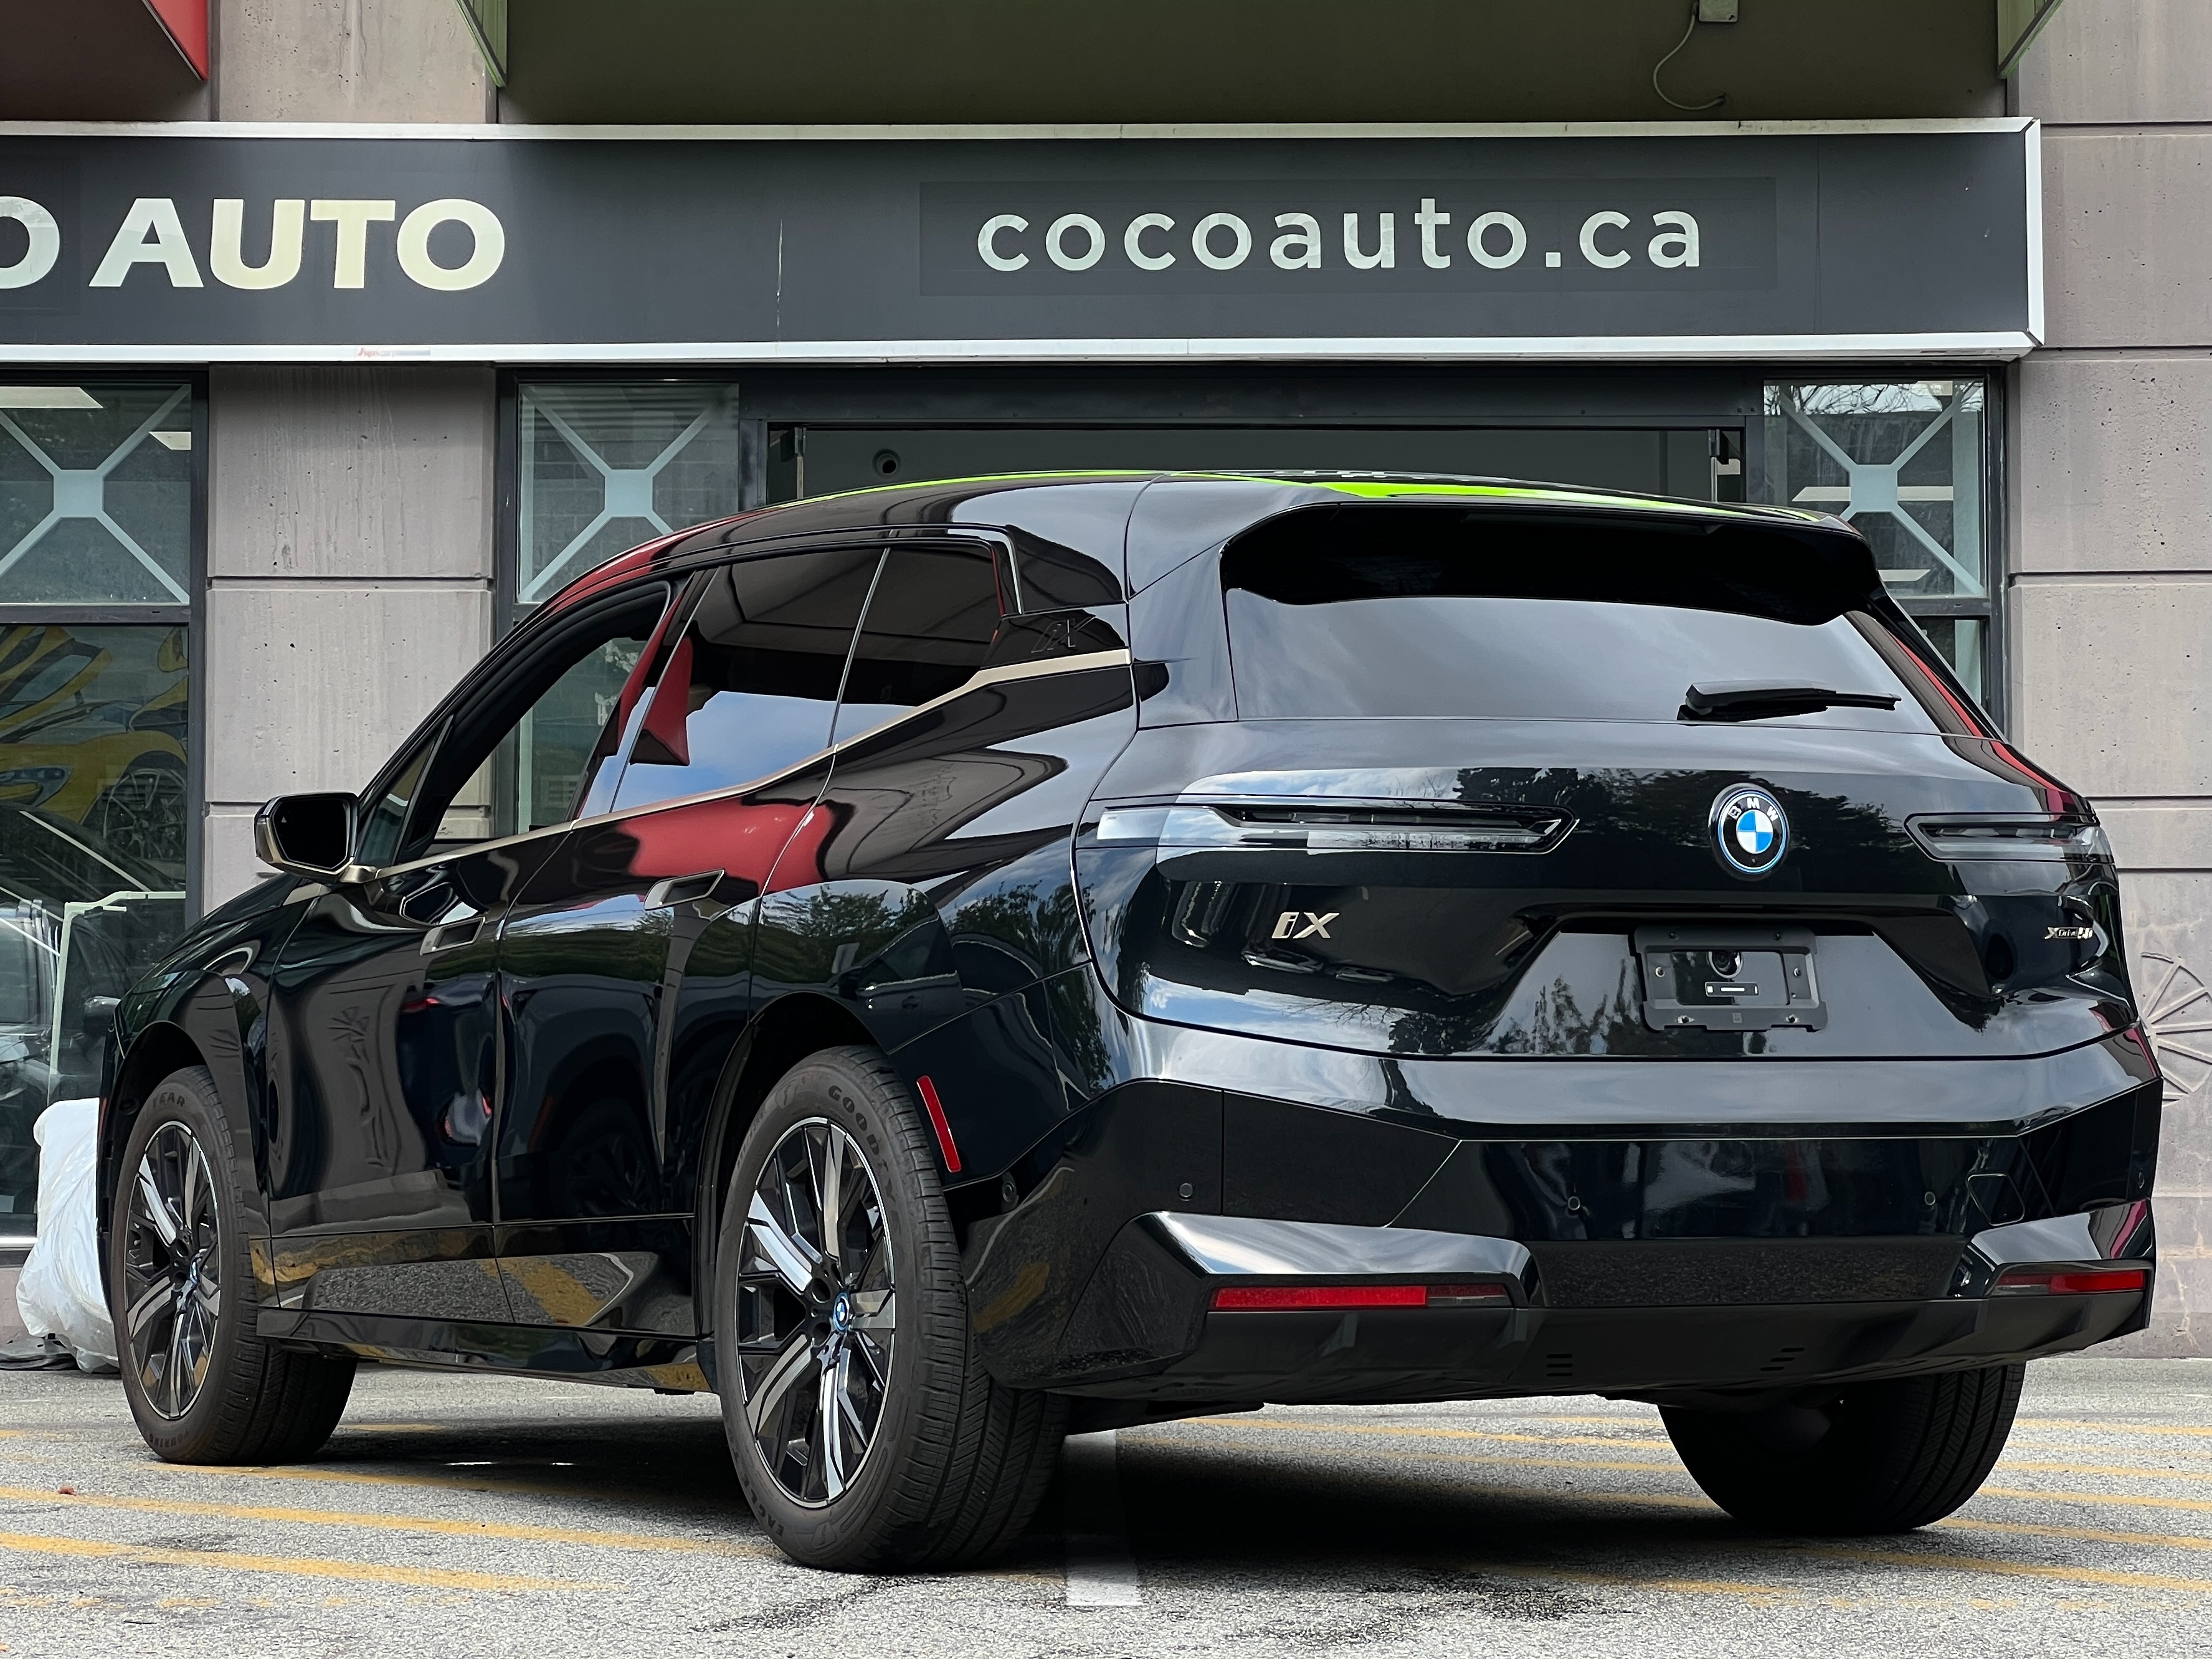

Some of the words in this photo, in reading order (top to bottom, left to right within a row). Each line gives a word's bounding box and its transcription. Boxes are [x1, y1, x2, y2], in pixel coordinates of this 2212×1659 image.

[89, 199, 505, 291] AUTO
[978, 199, 1699, 271] cocoauto.ca
[1727, 796, 1779, 820] BMW
[1271, 912, 1340, 939] iX
